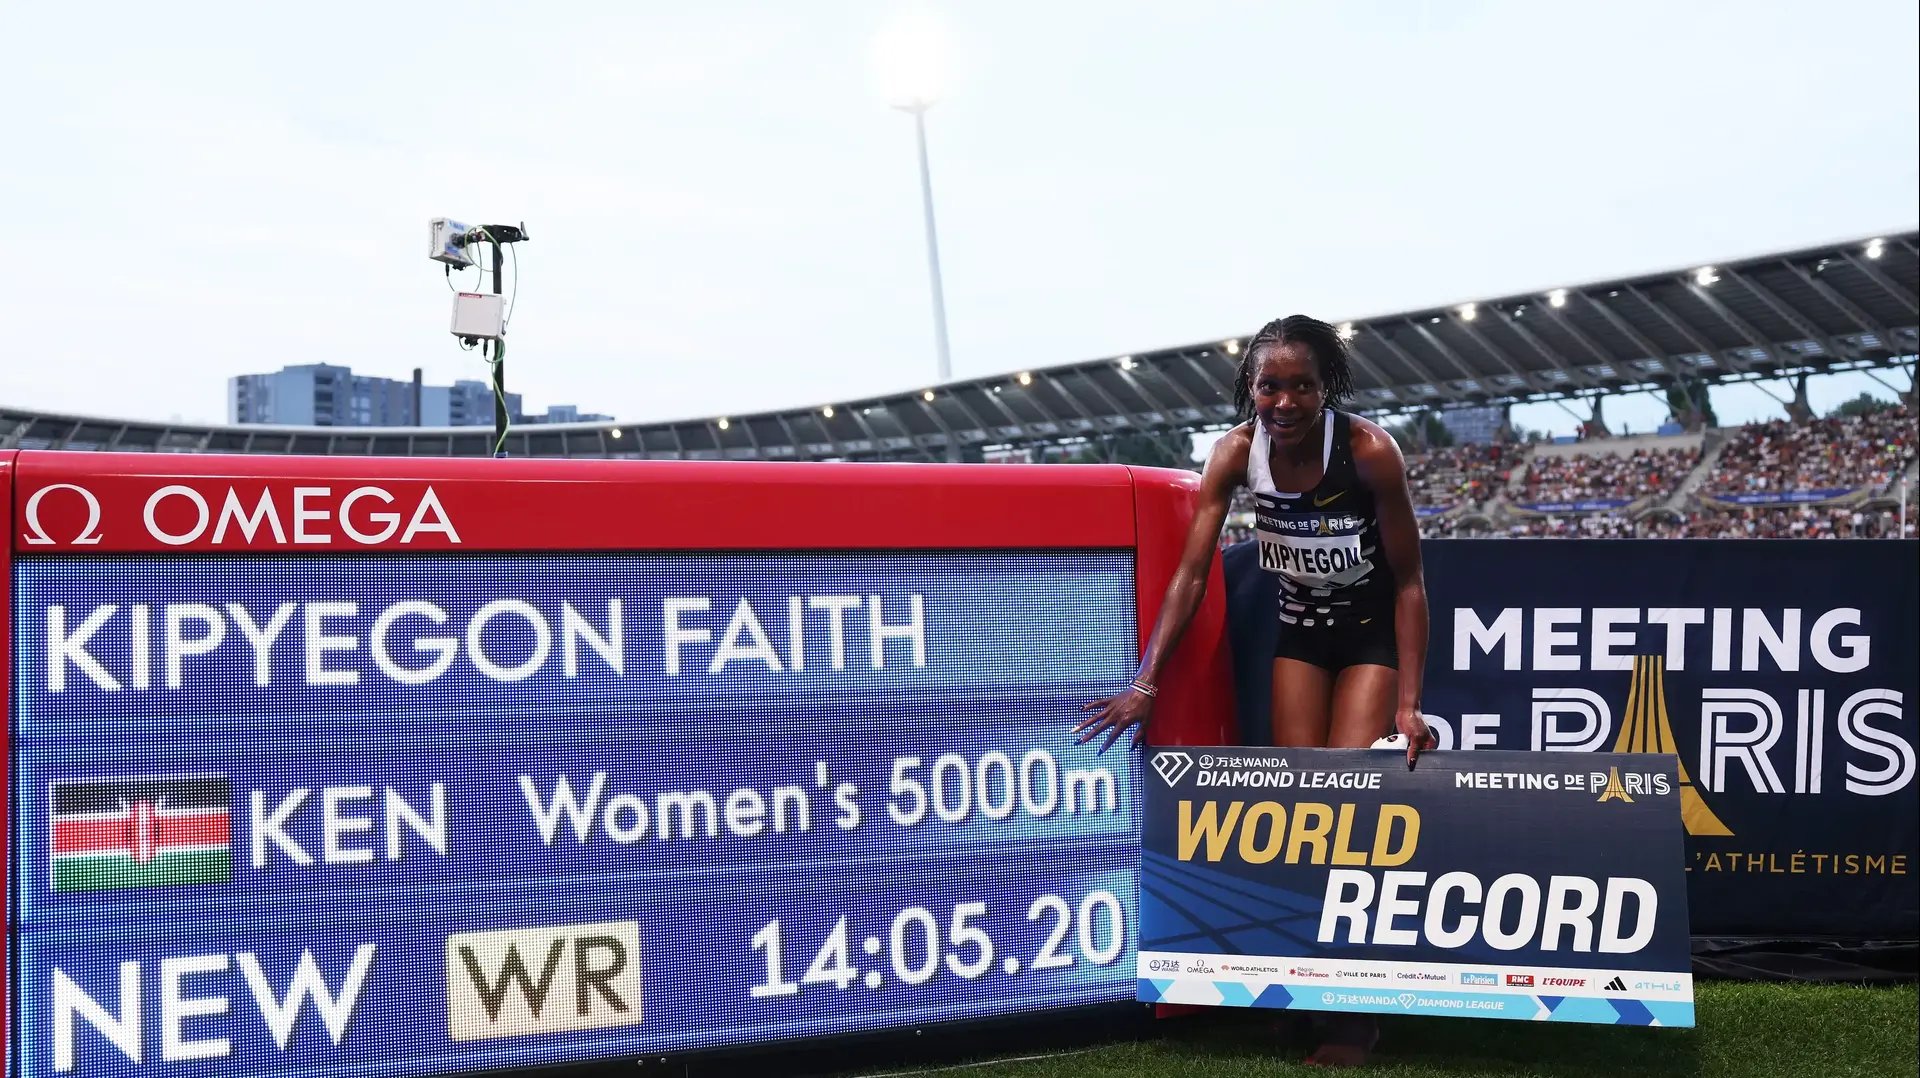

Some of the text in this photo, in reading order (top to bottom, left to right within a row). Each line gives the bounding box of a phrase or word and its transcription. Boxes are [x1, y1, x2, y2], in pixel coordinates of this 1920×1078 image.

[143, 485, 461, 545] OMEGA
[1257, 513, 1354, 536] MEETING DE PARIS
[1261, 541, 1361, 574] KIPYEGON
[46, 592, 927, 693] KIPYEGON FAITH
[1453, 607, 1871, 674] MEETING
[1530, 668, 1918, 824] PARIS
[249, 749, 1117, 869] KEN Women's 5000m
[1196, 770, 1383, 790] DIAMOND LEAGUE
[1455, 767, 1671, 802] MEETING DE PARIS
[1177, 800, 1421, 867] WORLD
[1685, 849, 1908, 876] ’ATHLÉTISME
[1317, 869, 1658, 954] RECORD
[750, 890, 1125, 999] 14:05.20
[1186, 966, 1215, 974] OMEGA
[458, 934, 630, 1023] WR
[1397, 972, 1417, 980] Crédit
[1417, 998, 1505, 1011] DIAMOND LEAGUE
[1511, 975, 1530, 984] RMC
[52, 943, 376, 1073] NEW
